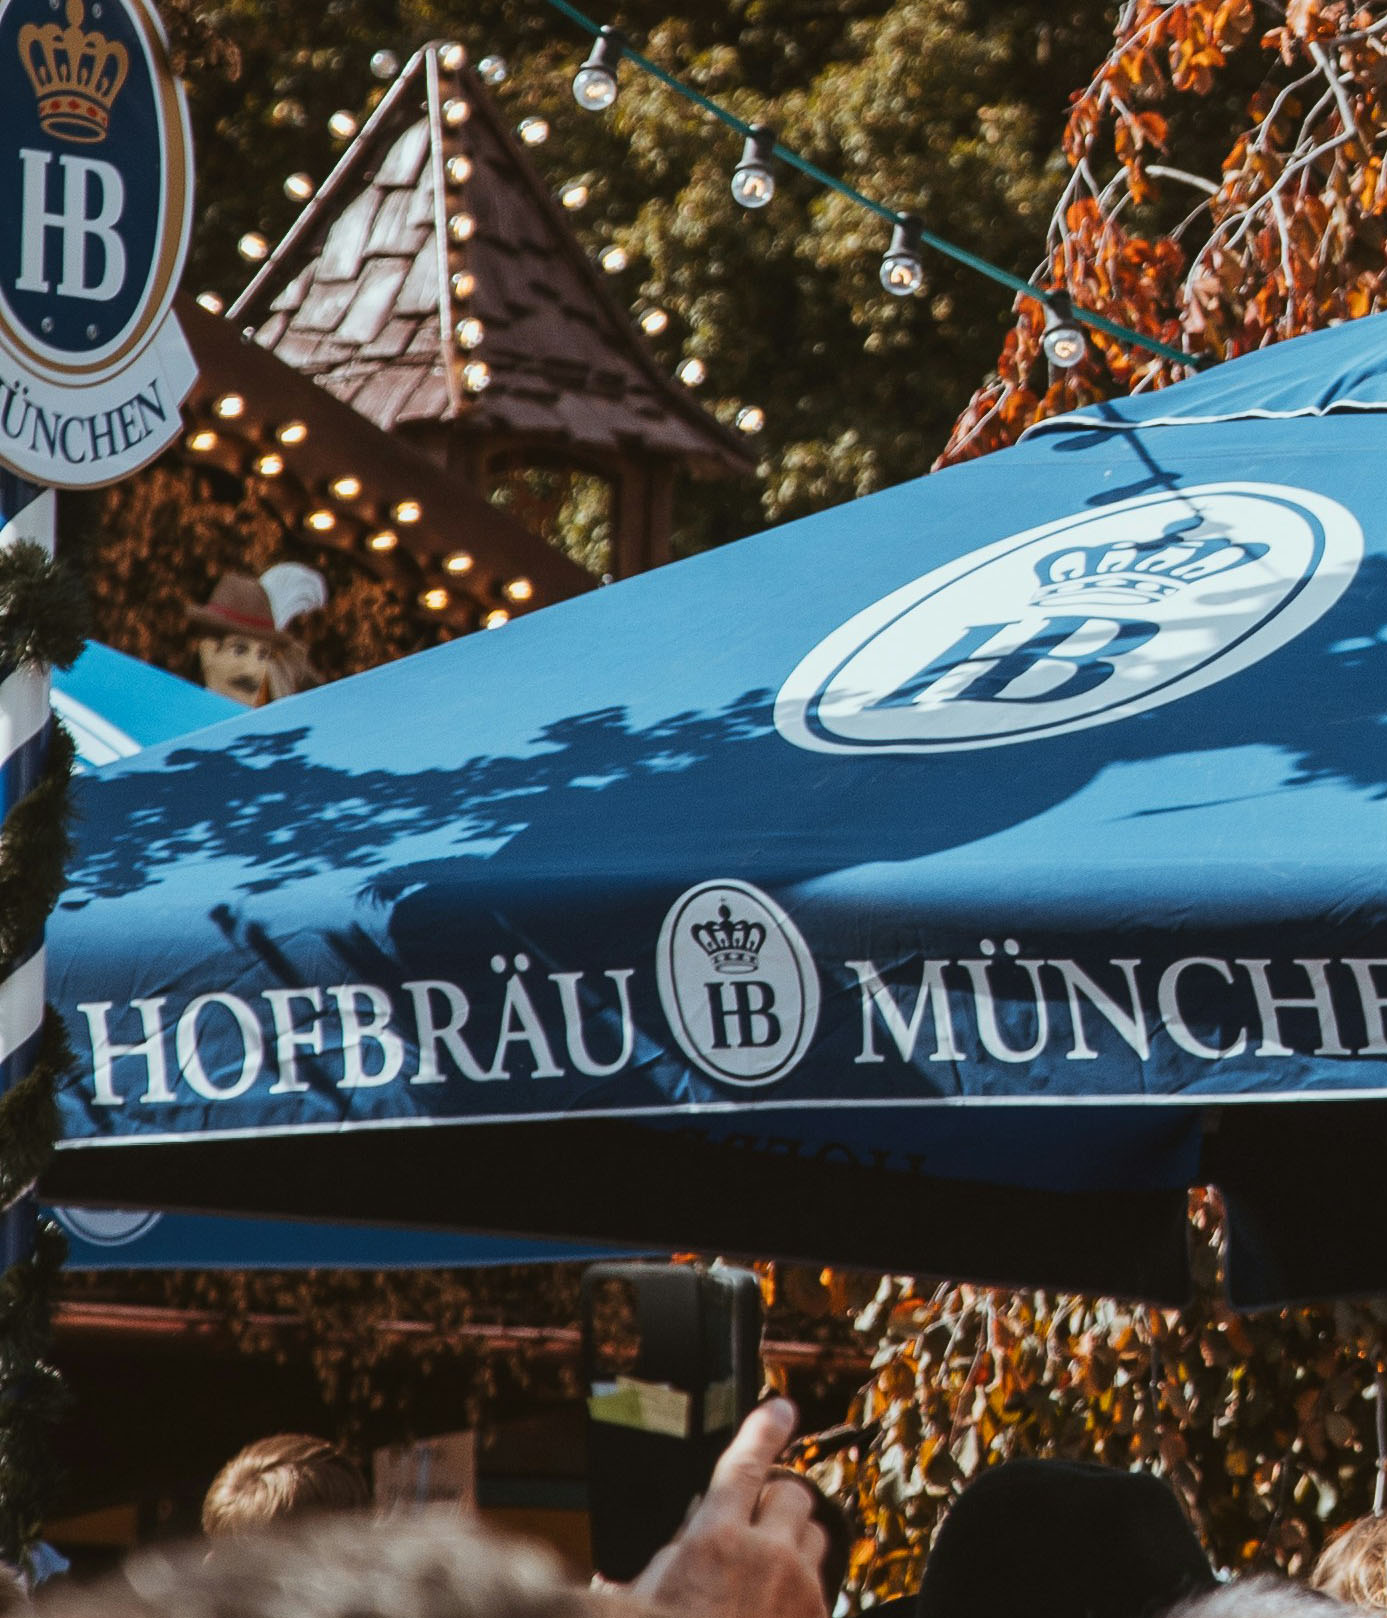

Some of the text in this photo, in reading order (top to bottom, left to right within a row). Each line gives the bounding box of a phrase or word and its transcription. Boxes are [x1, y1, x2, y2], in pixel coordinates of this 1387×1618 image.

[15, 148, 127, 301] HB
[0, 376, 167, 464] ÜNCHEN
[77, 954, 635, 1106] HOFBRÄU
[705, 980, 781, 1051] HB
